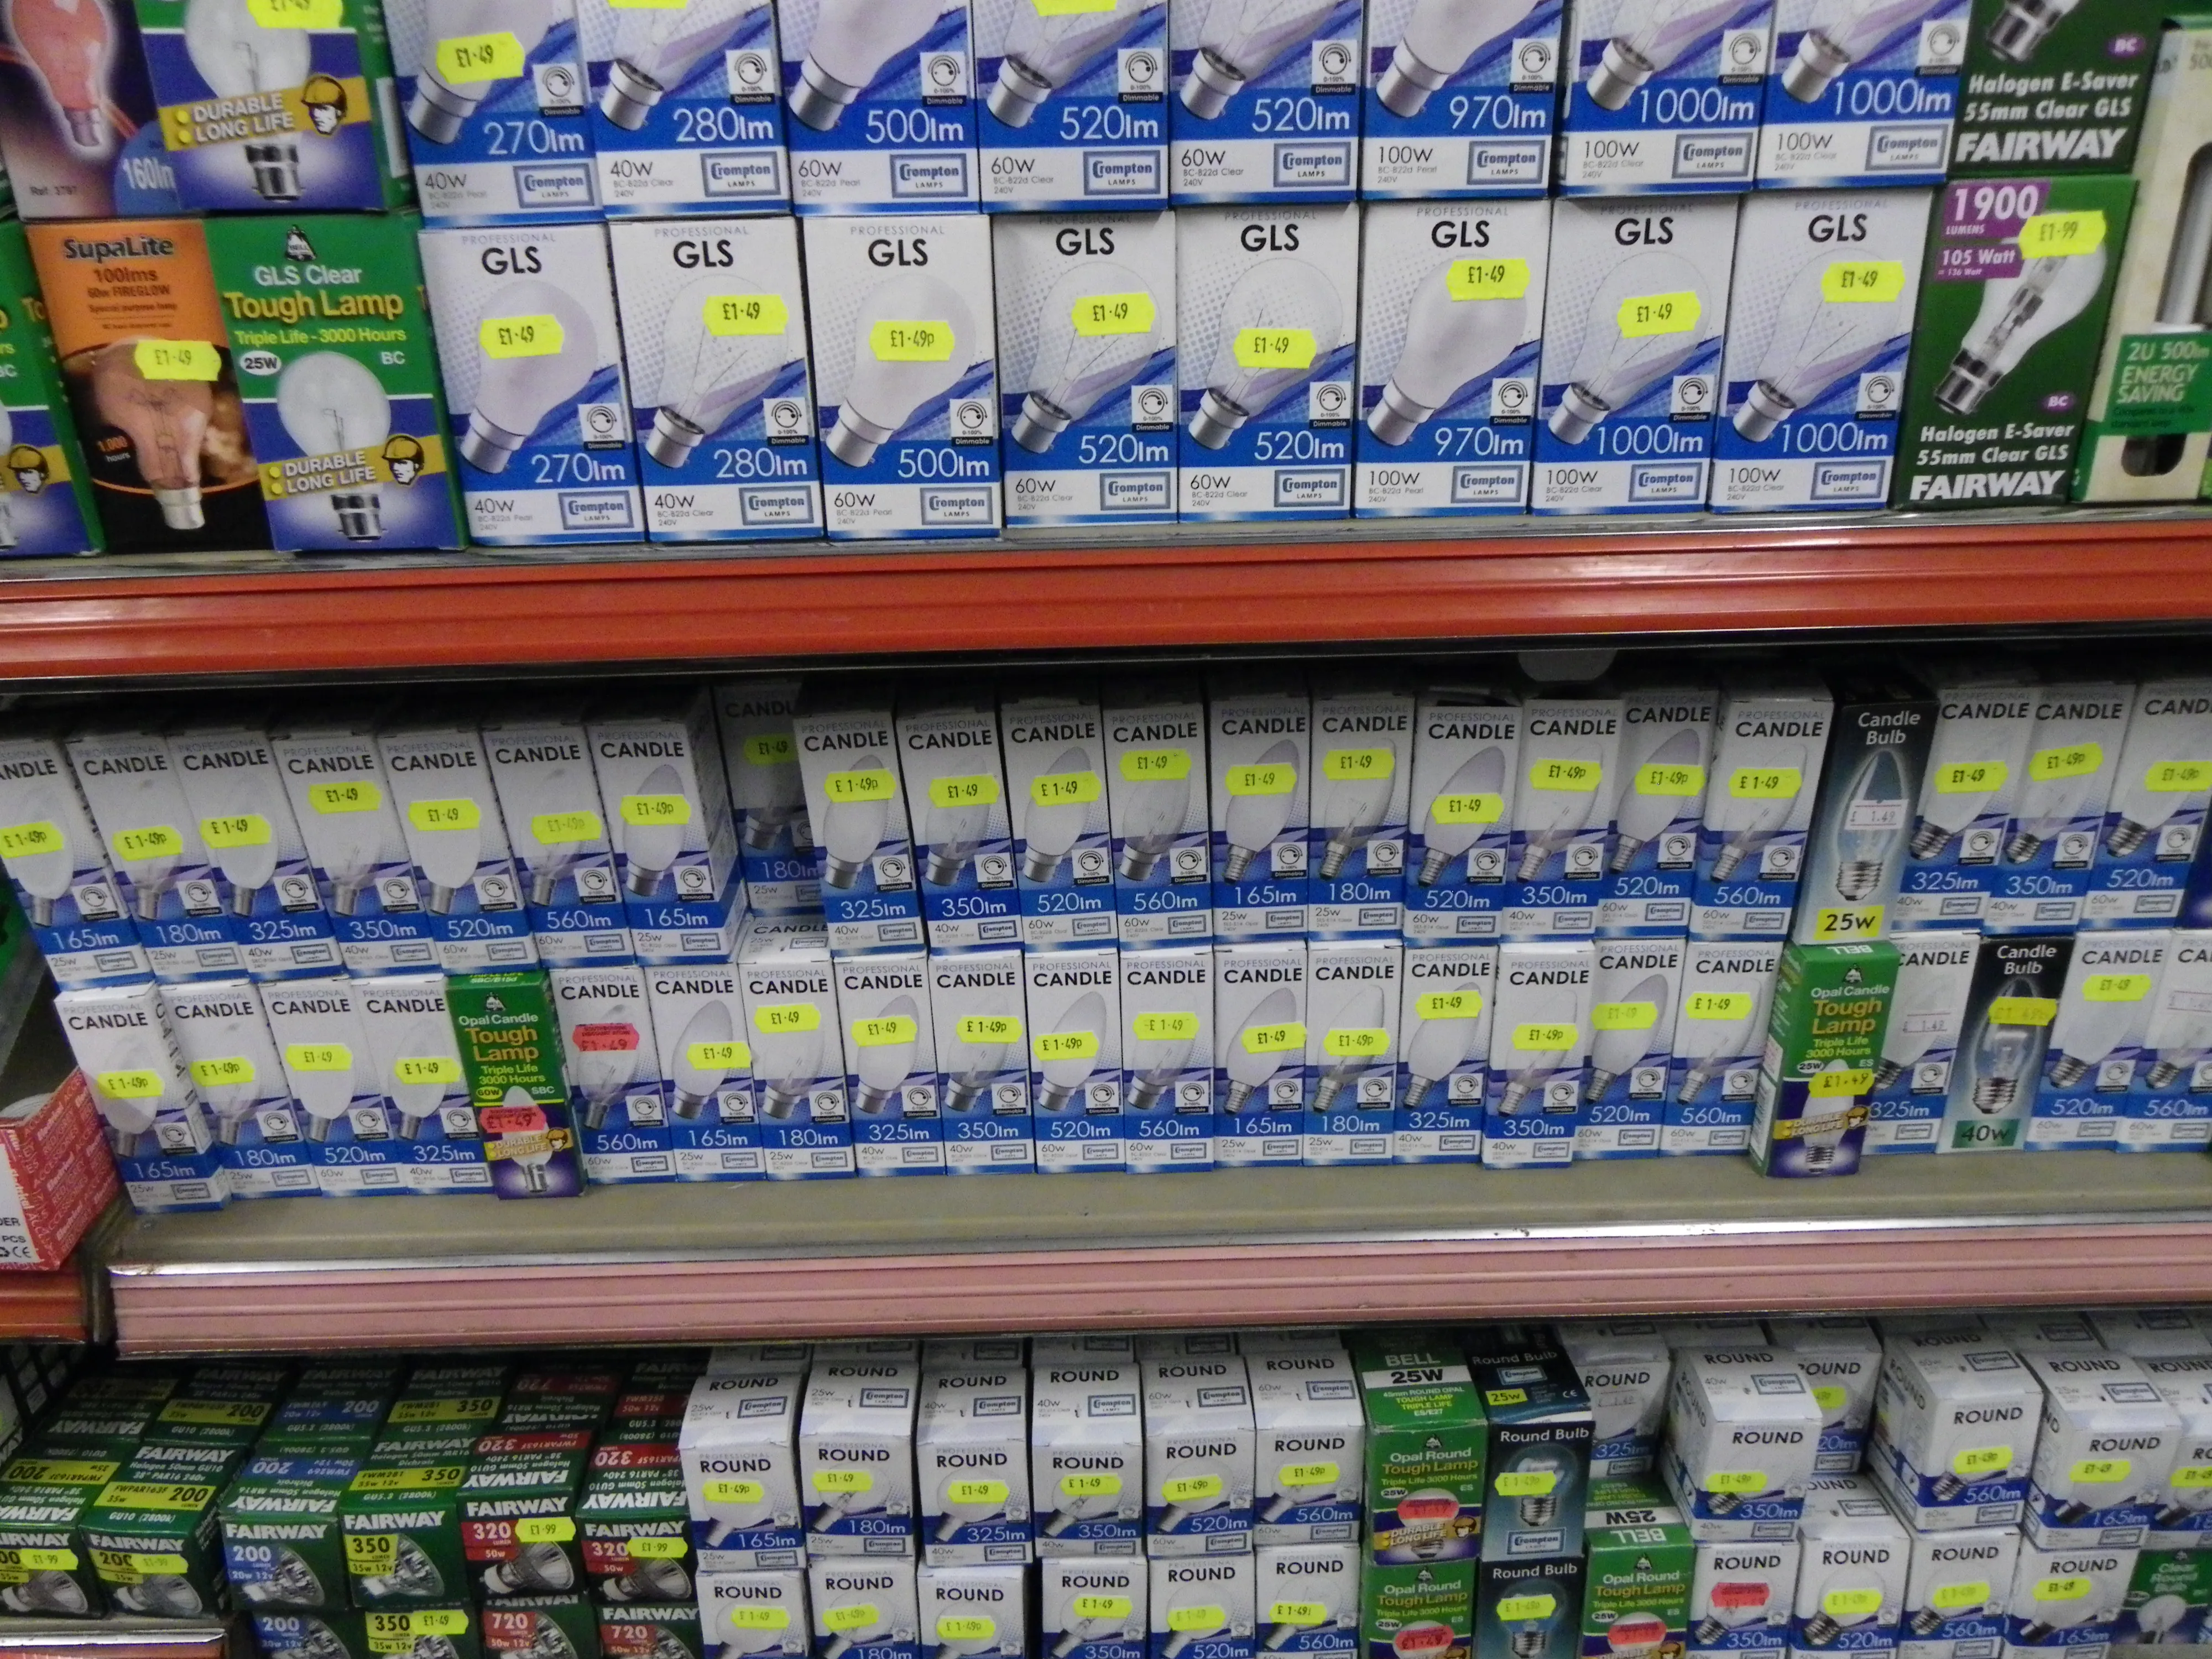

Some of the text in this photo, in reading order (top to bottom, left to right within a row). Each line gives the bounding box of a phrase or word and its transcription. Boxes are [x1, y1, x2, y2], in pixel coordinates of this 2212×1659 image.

[1969, 72, 2139, 97] Halogen E-Saver
[193, 93, 283, 122] DURABLE
[1450, 96, 1545, 129] 970lm
[1641, 88, 1754, 123] 1000lm
[1964, 97, 2132, 122] 55mm Clear GLS
[1252, 98, 1349, 132] 520lm
[195, 113, 295, 142] LONG LIFE
[674, 108, 773, 142] 280lm
[866, 109, 963, 143] 500lm
[485, 121, 585, 155] 270lm
[1955, 128, 2127, 162] FAIRWAY
[1379, 147, 1433, 163] 100W
[611, 160, 653, 176] 40W
[711, 163, 771, 180] Crompton
[799, 160, 842, 177] 60W
[1093, 161, 1152, 178] Crompton
[727, 180, 757, 188] LAMPS
[1955, 185, 2039, 221] 1900
[655, 226, 748, 237] PROFESSIONAL
[1809, 213, 1867, 243] GLS
[1947, 225, 1984, 234] LUMENS
[1241, 224, 1300, 251] GLS
[64, 238, 173, 262] SupaLite
[674, 239, 733, 268] GLS
[868, 239, 928, 266] GLS
[1943, 249, 2016, 265] 105 Watt
[95, 269, 158, 284] 100lms
[254, 265, 362, 286] GLS Clear
[113, 285, 170, 296] FIREGLOW
[224, 291, 404, 324] Tough Lamp
[234, 328, 406, 345] Triple Life 3000 Hours
[381, 352, 405, 365] BC
[2127, 342, 2155, 361] 2U
[244, 356, 277, 370] 25W
[2121, 365, 2199, 385] ENERGY
[2048, 395, 2067, 407] BC
[2117, 385, 2185, 403] SAVING
[770, 436, 807, 445] Dimmable
[1255, 431, 1344, 460] 520lm
[1436, 427, 1523, 456] 970lm
[1782, 422, 1887, 453] 1000lm
[286, 452, 366, 477] DURABLE
[531, 453, 625, 482] 270lm
[714, 448, 807, 478] 280lm
[898, 448, 989, 477] 500lm
[286, 467, 375, 494] LONG LIFE
[1370, 471, 1420, 486] 100W
[1729, 468, 1781, 483] 100W
[1284, 478, 1337, 493] Crompton
[1910, 470, 2065, 500] FAIRWAY
[655, 494, 694, 509] 40W
[834, 493, 875, 508] 60W
[929, 497, 984, 512] Crompton
[2036, 703, 2122, 719] CANDLE
[1858, 711, 1921, 728] Candle
[1113, 722, 1197, 743] CANDLE
[1428, 724, 1515, 740] CANDLE
[1736, 722, 1823, 737] CANDLE
[1866, 730, 1906, 745] Bulb
[183, 749, 269, 770] CANDLE
[495, 744, 581, 764] CANDLE
[2005, 876, 2073, 894] 350lm
[942, 897, 1007, 916] 350lm
[1425, 890, 1490, 909] 520lm
[547, 912, 612, 928] 560lm
[250, 921, 317, 940] 325lm
[1997, 946, 2058, 958] Candle
[1224, 968, 1302, 982] CANDLE
[2004, 961, 2043, 974] Bulb
[655, 980, 734, 994] CANDLE
[844, 974, 923, 989] CANDLE
[1811, 984, 1890, 998] Opal Candle
[1814, 1000, 1882, 1017] Tough
[69, 1013, 148, 1030] CANDLE
[459, 1013, 538, 1026] Opal Candle
[1812, 1019, 1875, 1035] Lamp
[465, 1026, 538, 1044] Tough
[474, 1045, 539, 1063] Lamp
[481, 1065, 538, 1074] Triple Life
[479, 1073, 545, 1084] 3000 Hours
[531, 1086, 555, 1094] SBC
[869, 1124, 929, 1140] 325lm
[1234, 1117, 1292, 1133] 165lm
[1504, 1119, 1564, 1136] 350lm
[134, 1162, 196, 1177] 165lm
[1385, 1353, 1440, 1366] BELL
[828, 1366, 898, 1378] ROUND
[1391, 1369, 1444, 1384] 25W
[1954, 1407, 2023, 1425] ROUND
[1500, 1427, 1589, 1443] Round Bulb
[1733, 1431, 1803, 1444] ROUND
[135, 1446, 235, 1463] FAIRWAY
[1166, 1444, 1237, 1458] ROUND
[1390, 1448, 1472, 1463] Opal Round
[700, 1459, 771, 1473] ROUND
[1383, 1459, 1478, 1475] Tough Lamp
[169, 1487, 208, 1503] 200
[1965, 1489, 2021, 1503] 560lm
[345, 1511, 445, 1530] FAIRWAY
[1191, 1516, 1248, 1532] 520lm
[226, 1524, 327, 1540] FAIRWAY
[473, 1522, 512, 1539] 320
[352, 1537, 390, 1553] 350
[739, 1534, 796, 1548] 165lm
[233, 1545, 271, 1562] 200
[492, 1613, 529, 1629] 720
